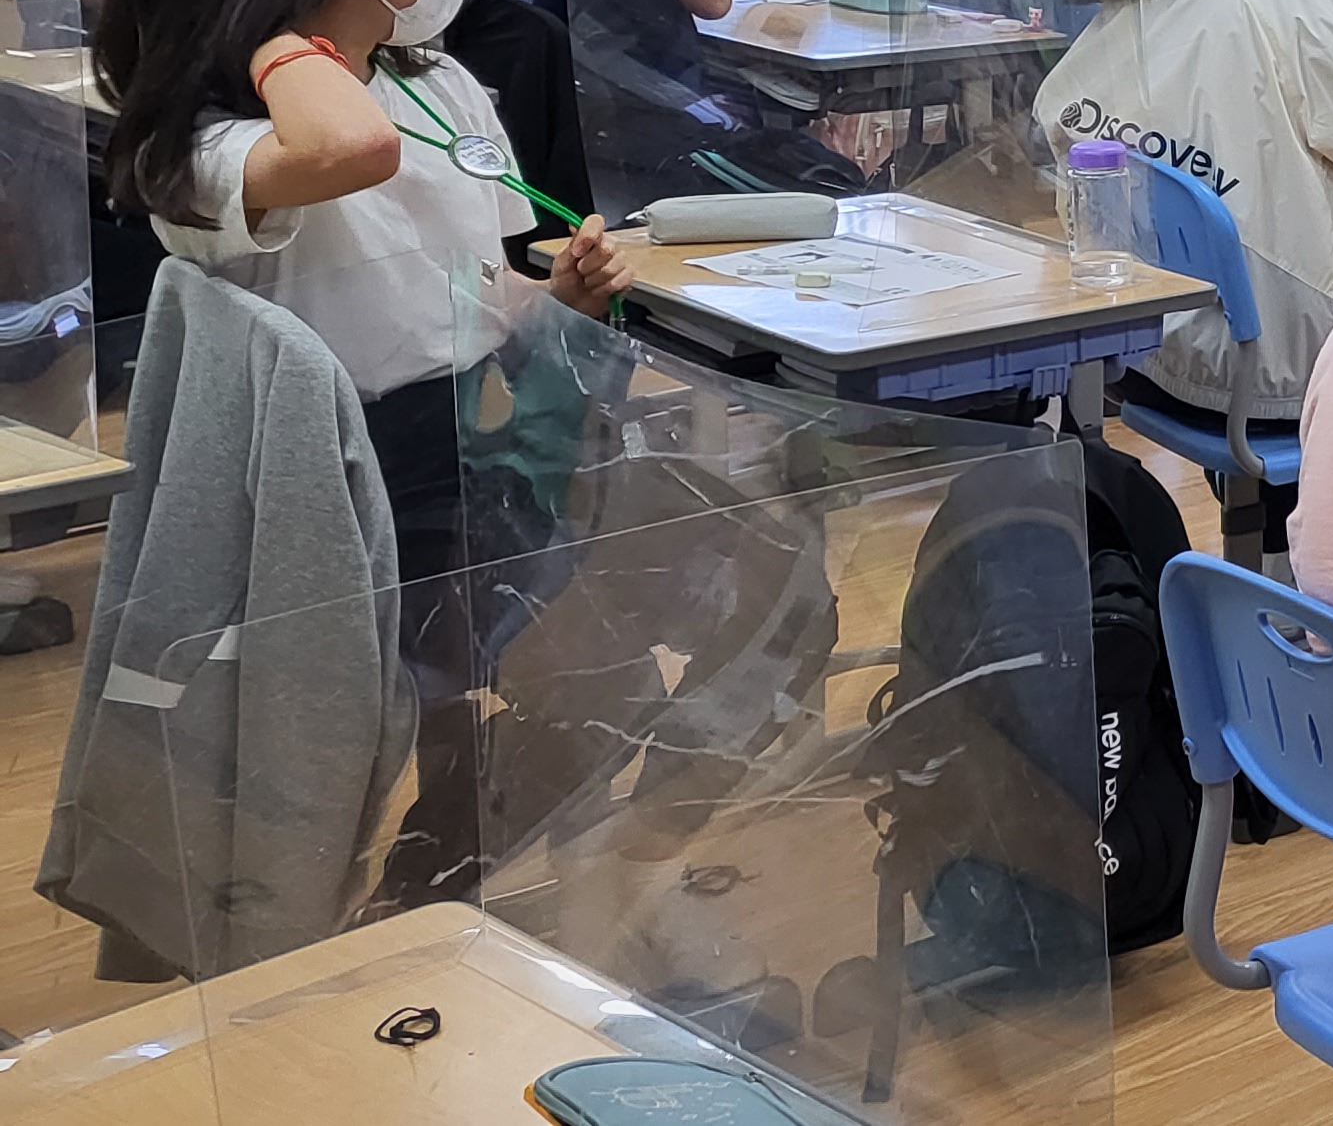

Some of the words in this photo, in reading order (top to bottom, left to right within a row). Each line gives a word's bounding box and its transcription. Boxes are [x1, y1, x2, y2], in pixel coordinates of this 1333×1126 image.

[1074, 97, 1240, 198] Discovey
[1101, 711, 1122, 769] new
[1094, 775, 1120, 876] bace
